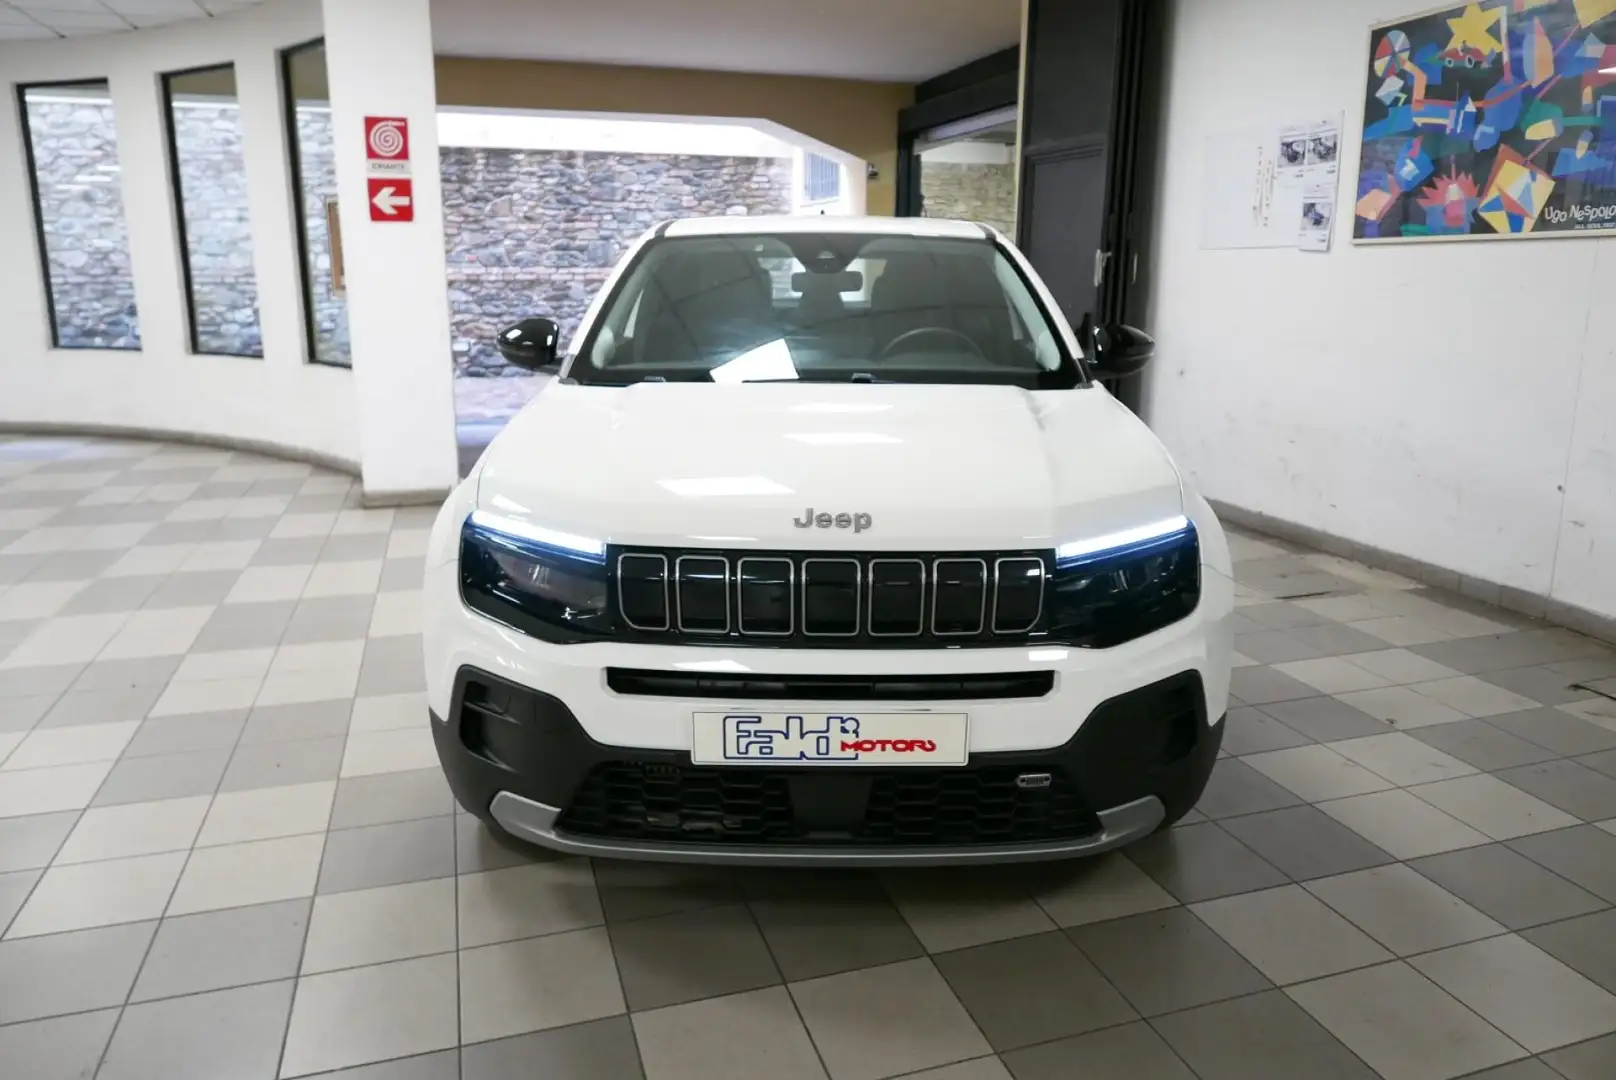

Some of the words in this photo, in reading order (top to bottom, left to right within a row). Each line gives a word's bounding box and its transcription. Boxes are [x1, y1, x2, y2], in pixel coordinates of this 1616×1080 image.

[1544, 205, 1568, 224] Ugo
[792, 507, 872, 533] Jeep
[840, 739, 936, 752] MOTORS
